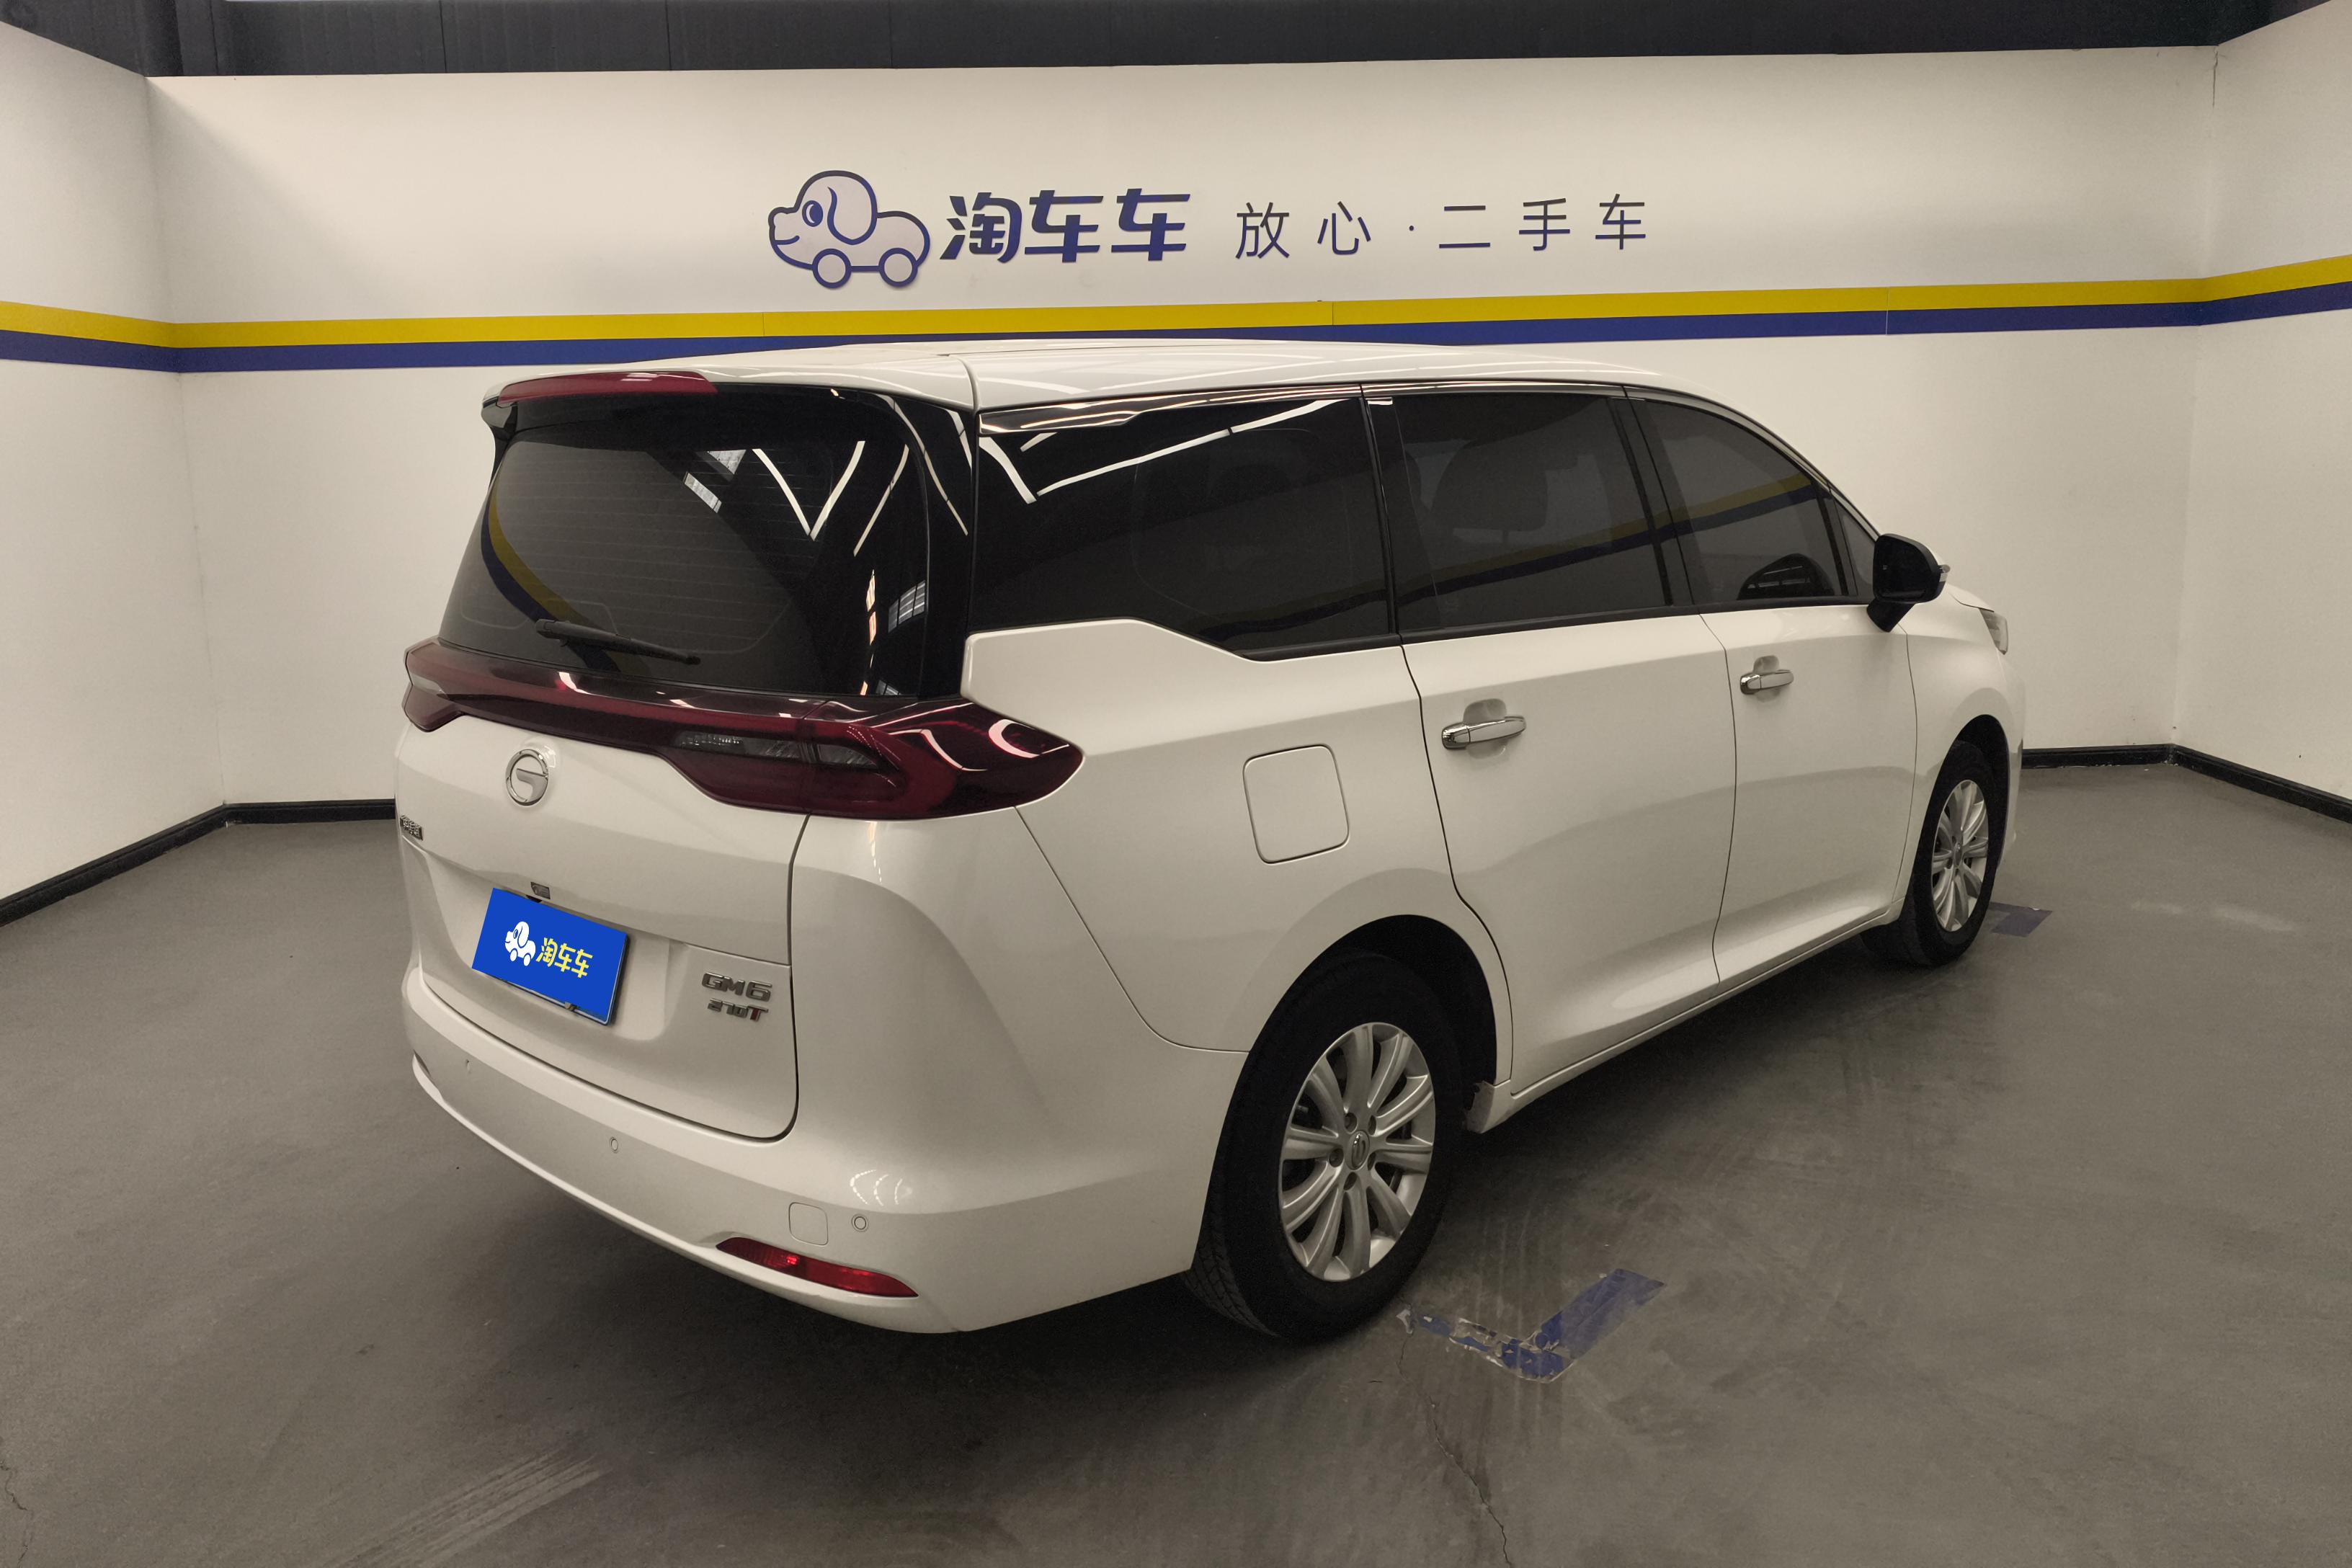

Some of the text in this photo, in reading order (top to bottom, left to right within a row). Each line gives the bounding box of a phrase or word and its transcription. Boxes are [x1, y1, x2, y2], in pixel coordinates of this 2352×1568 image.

[940, 188, 1190, 264] 淘车车
[701, 971, 772, 1002] GM6
